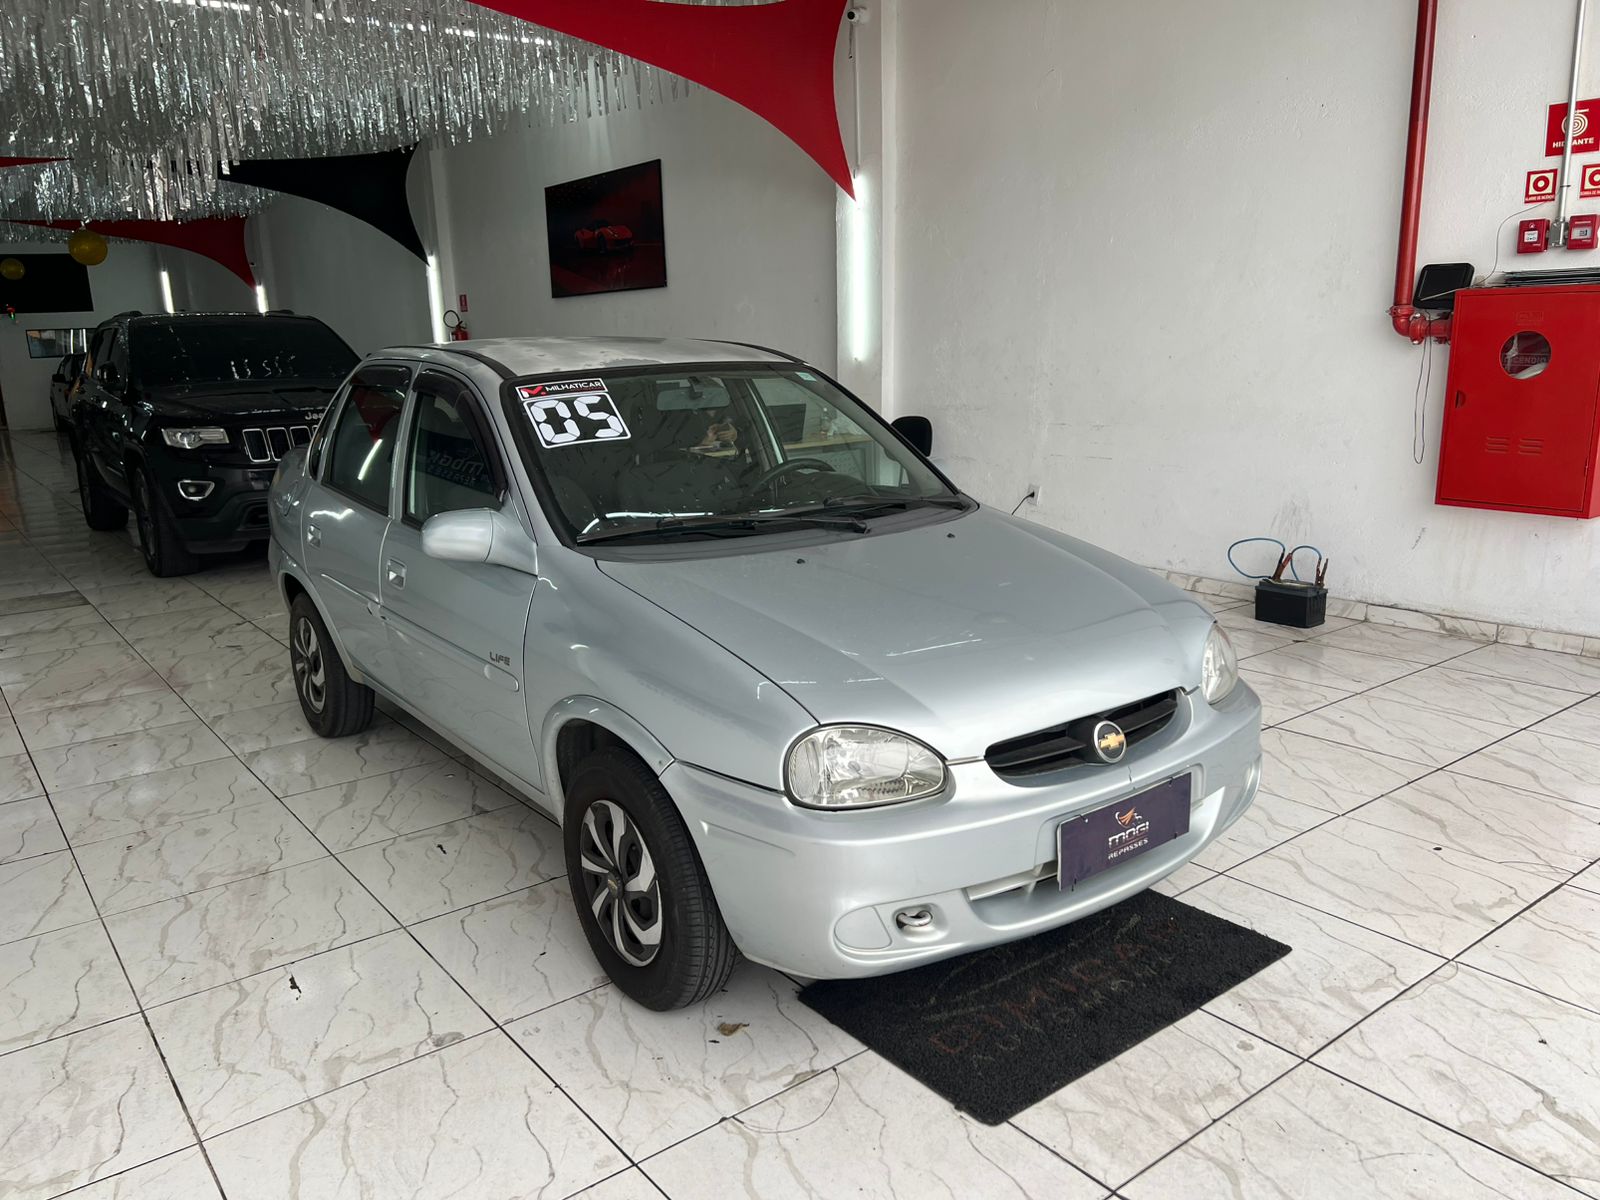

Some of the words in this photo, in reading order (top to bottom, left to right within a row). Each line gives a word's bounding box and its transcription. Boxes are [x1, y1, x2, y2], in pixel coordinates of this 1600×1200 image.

[1552, 137, 1594, 148] HIANTE
[545, 381, 602, 392] MILHATICAR
[304, 411, 324, 420] Jee
[530, 395, 623, 443] 05
[489, 651, 510, 666] LIFE
[1108, 821, 1149, 848] MOGI
[1107, 838, 1149, 860] REPASSES
